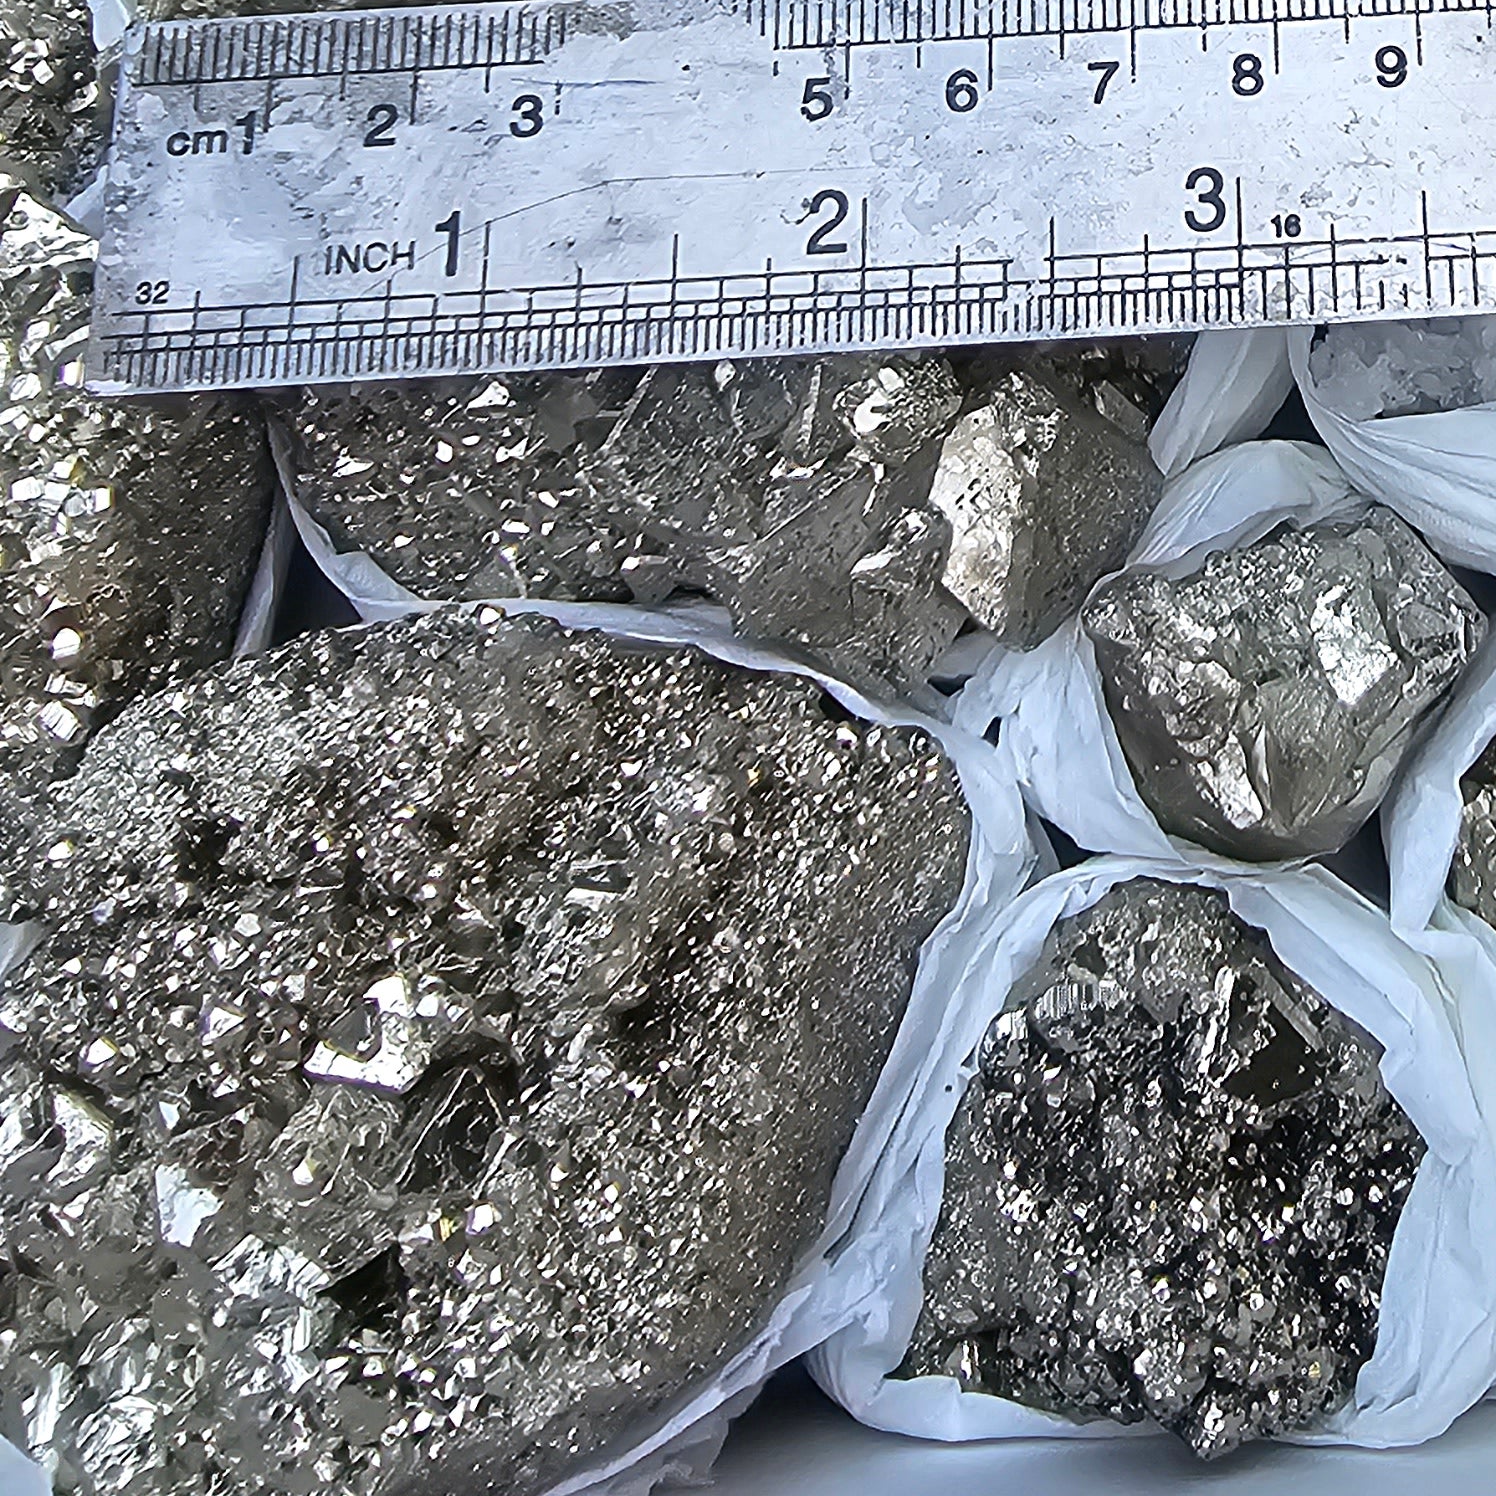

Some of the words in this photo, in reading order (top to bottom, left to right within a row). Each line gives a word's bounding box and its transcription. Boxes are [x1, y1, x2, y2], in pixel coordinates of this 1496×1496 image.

[363, 104, 397, 147] 2
[508, 94, 544, 138] 3
[799, 77, 834, 122] 5
[945, 68, 979, 112] 6
[1086, 61, 1120, 104] 7
[1231, 53, 1264, 96] 8
[1375, 45, 1408, 87] 9
[323, 239, 416, 276] INCH
[435, 210, 461, 277] 1
[806, 189, 849, 255] 2
[1184, 167, 1225, 232] 3
[1270, 214, 1301, 238] 16
[135, 280, 170, 305] 32
